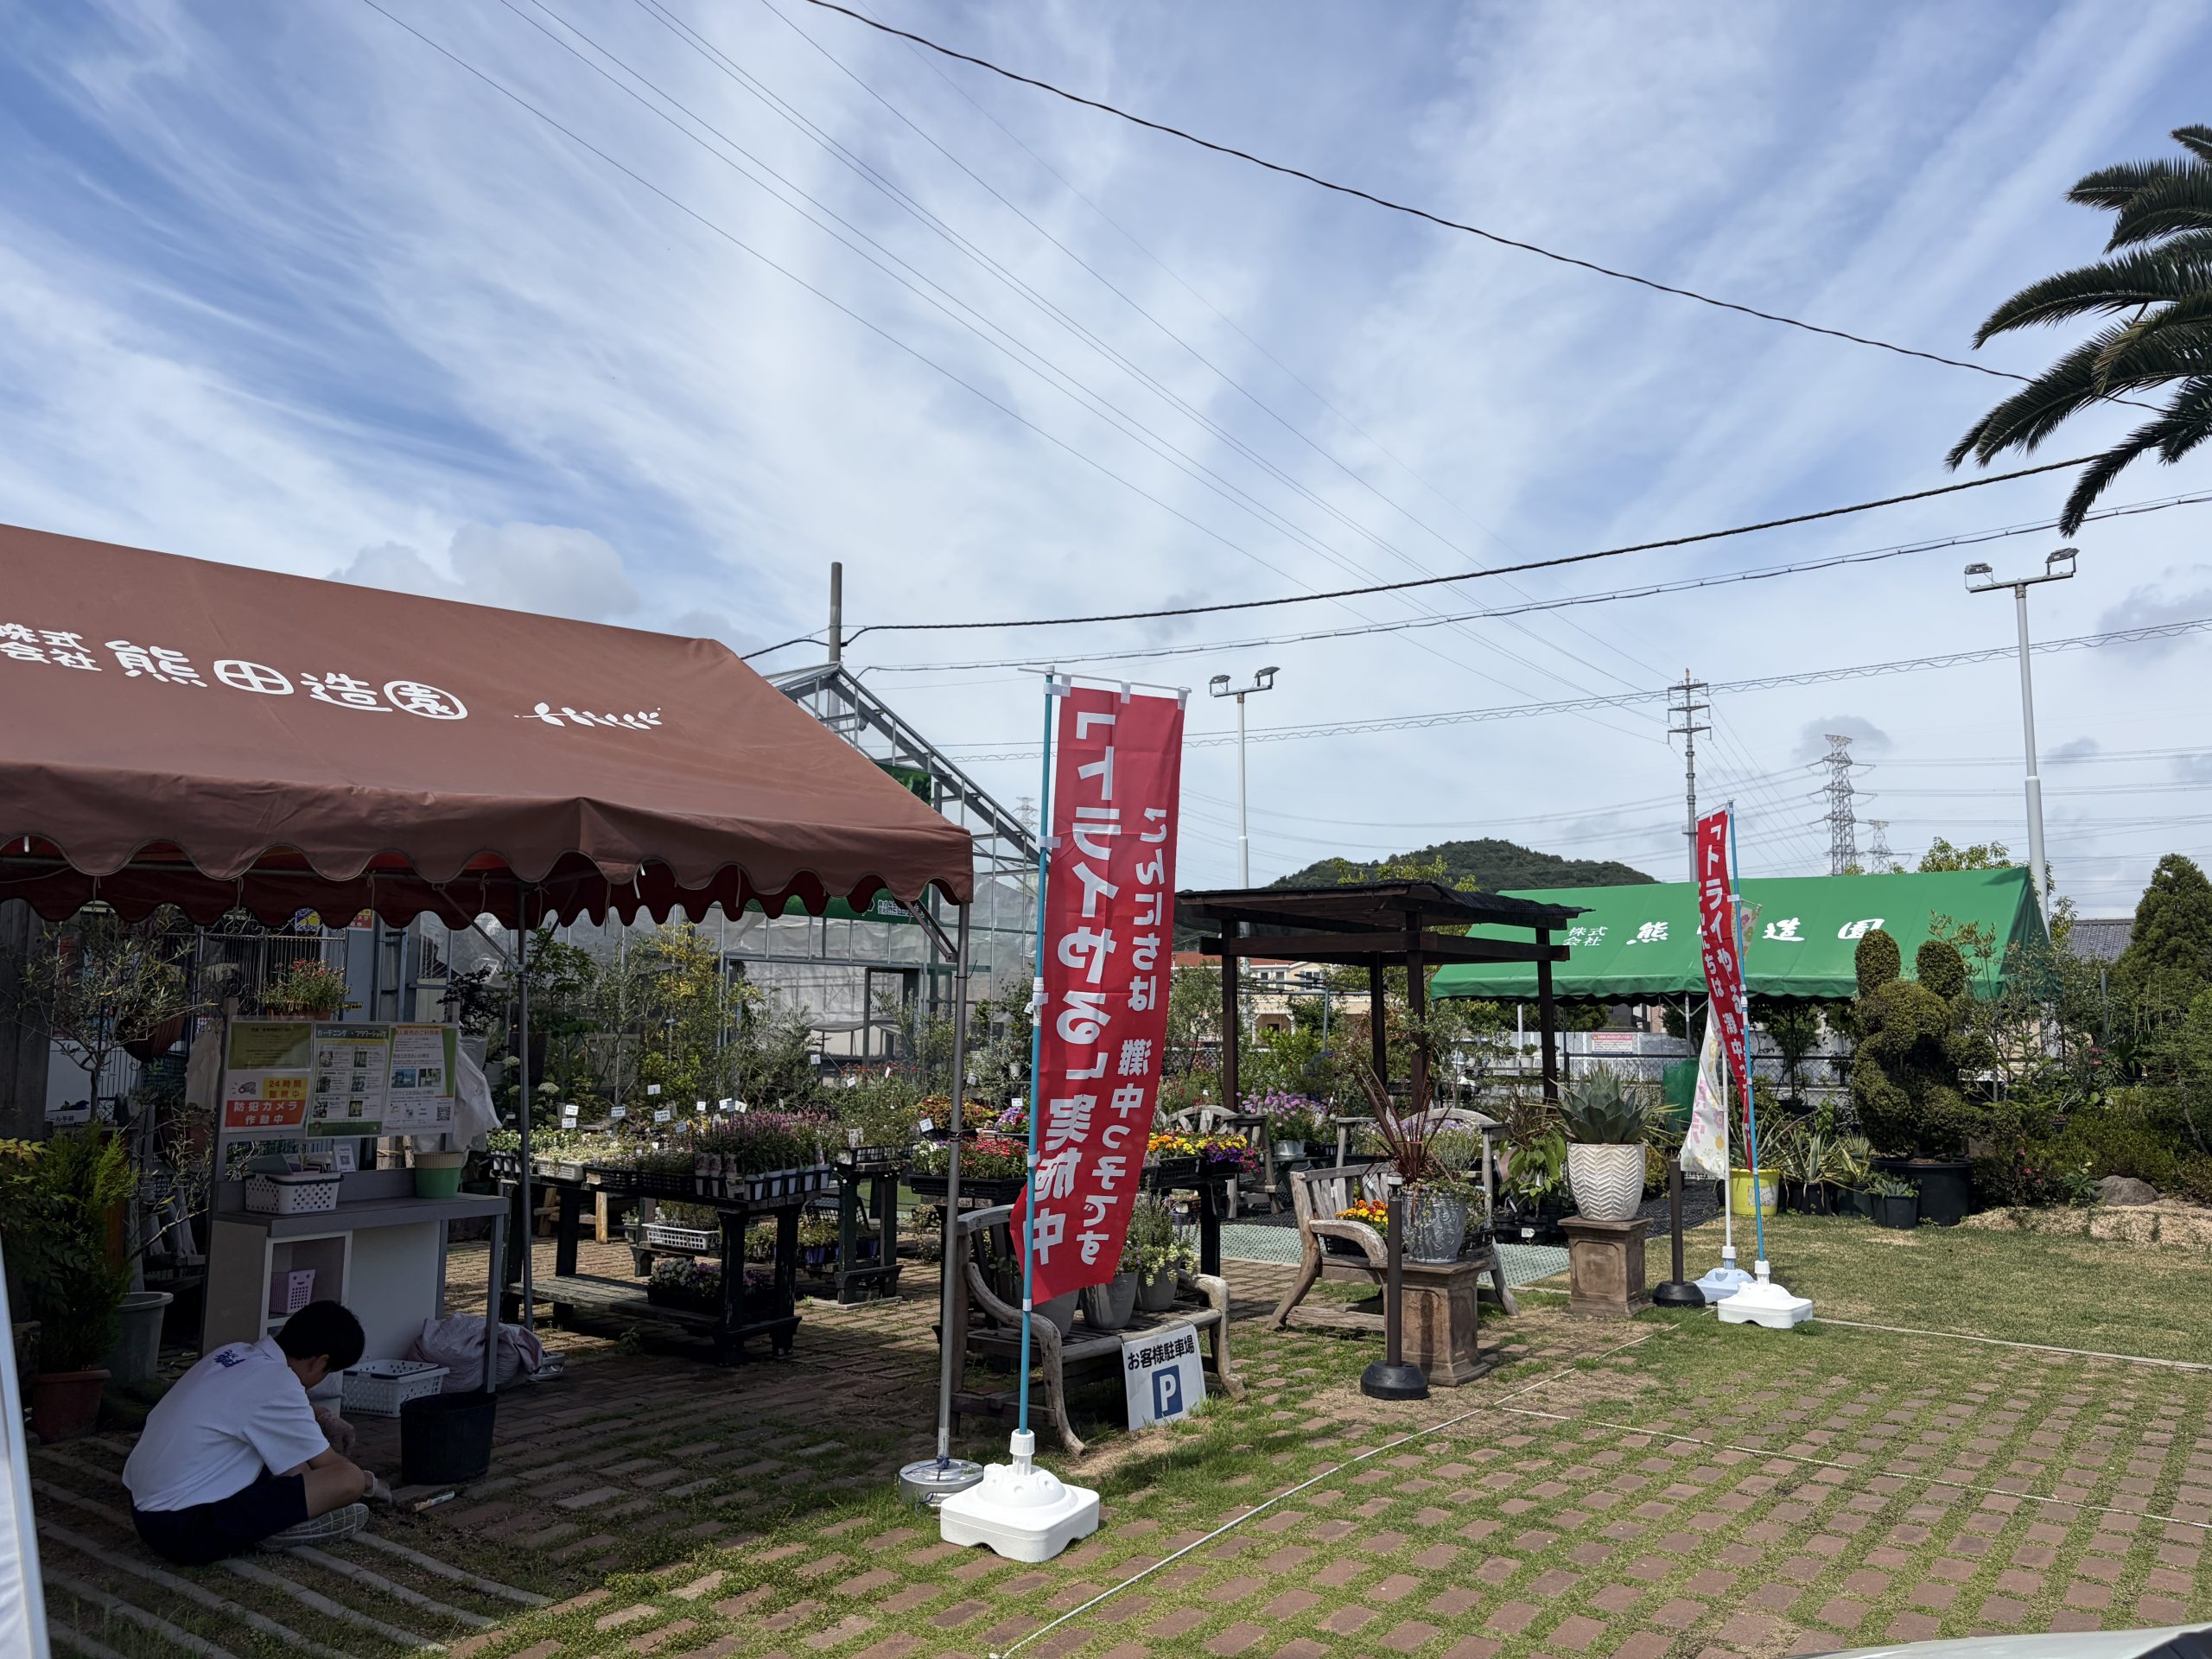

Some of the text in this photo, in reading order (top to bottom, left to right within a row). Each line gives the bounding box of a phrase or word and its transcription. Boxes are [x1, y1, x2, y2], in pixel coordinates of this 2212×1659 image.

[233, 1101, 297, 1113] 防犯カメラ
[245, 1115, 283, 1125] 作動中
[1128, 1334, 1195, 1371] お客様駐車場
[1159, 1374, 1177, 1412] P
